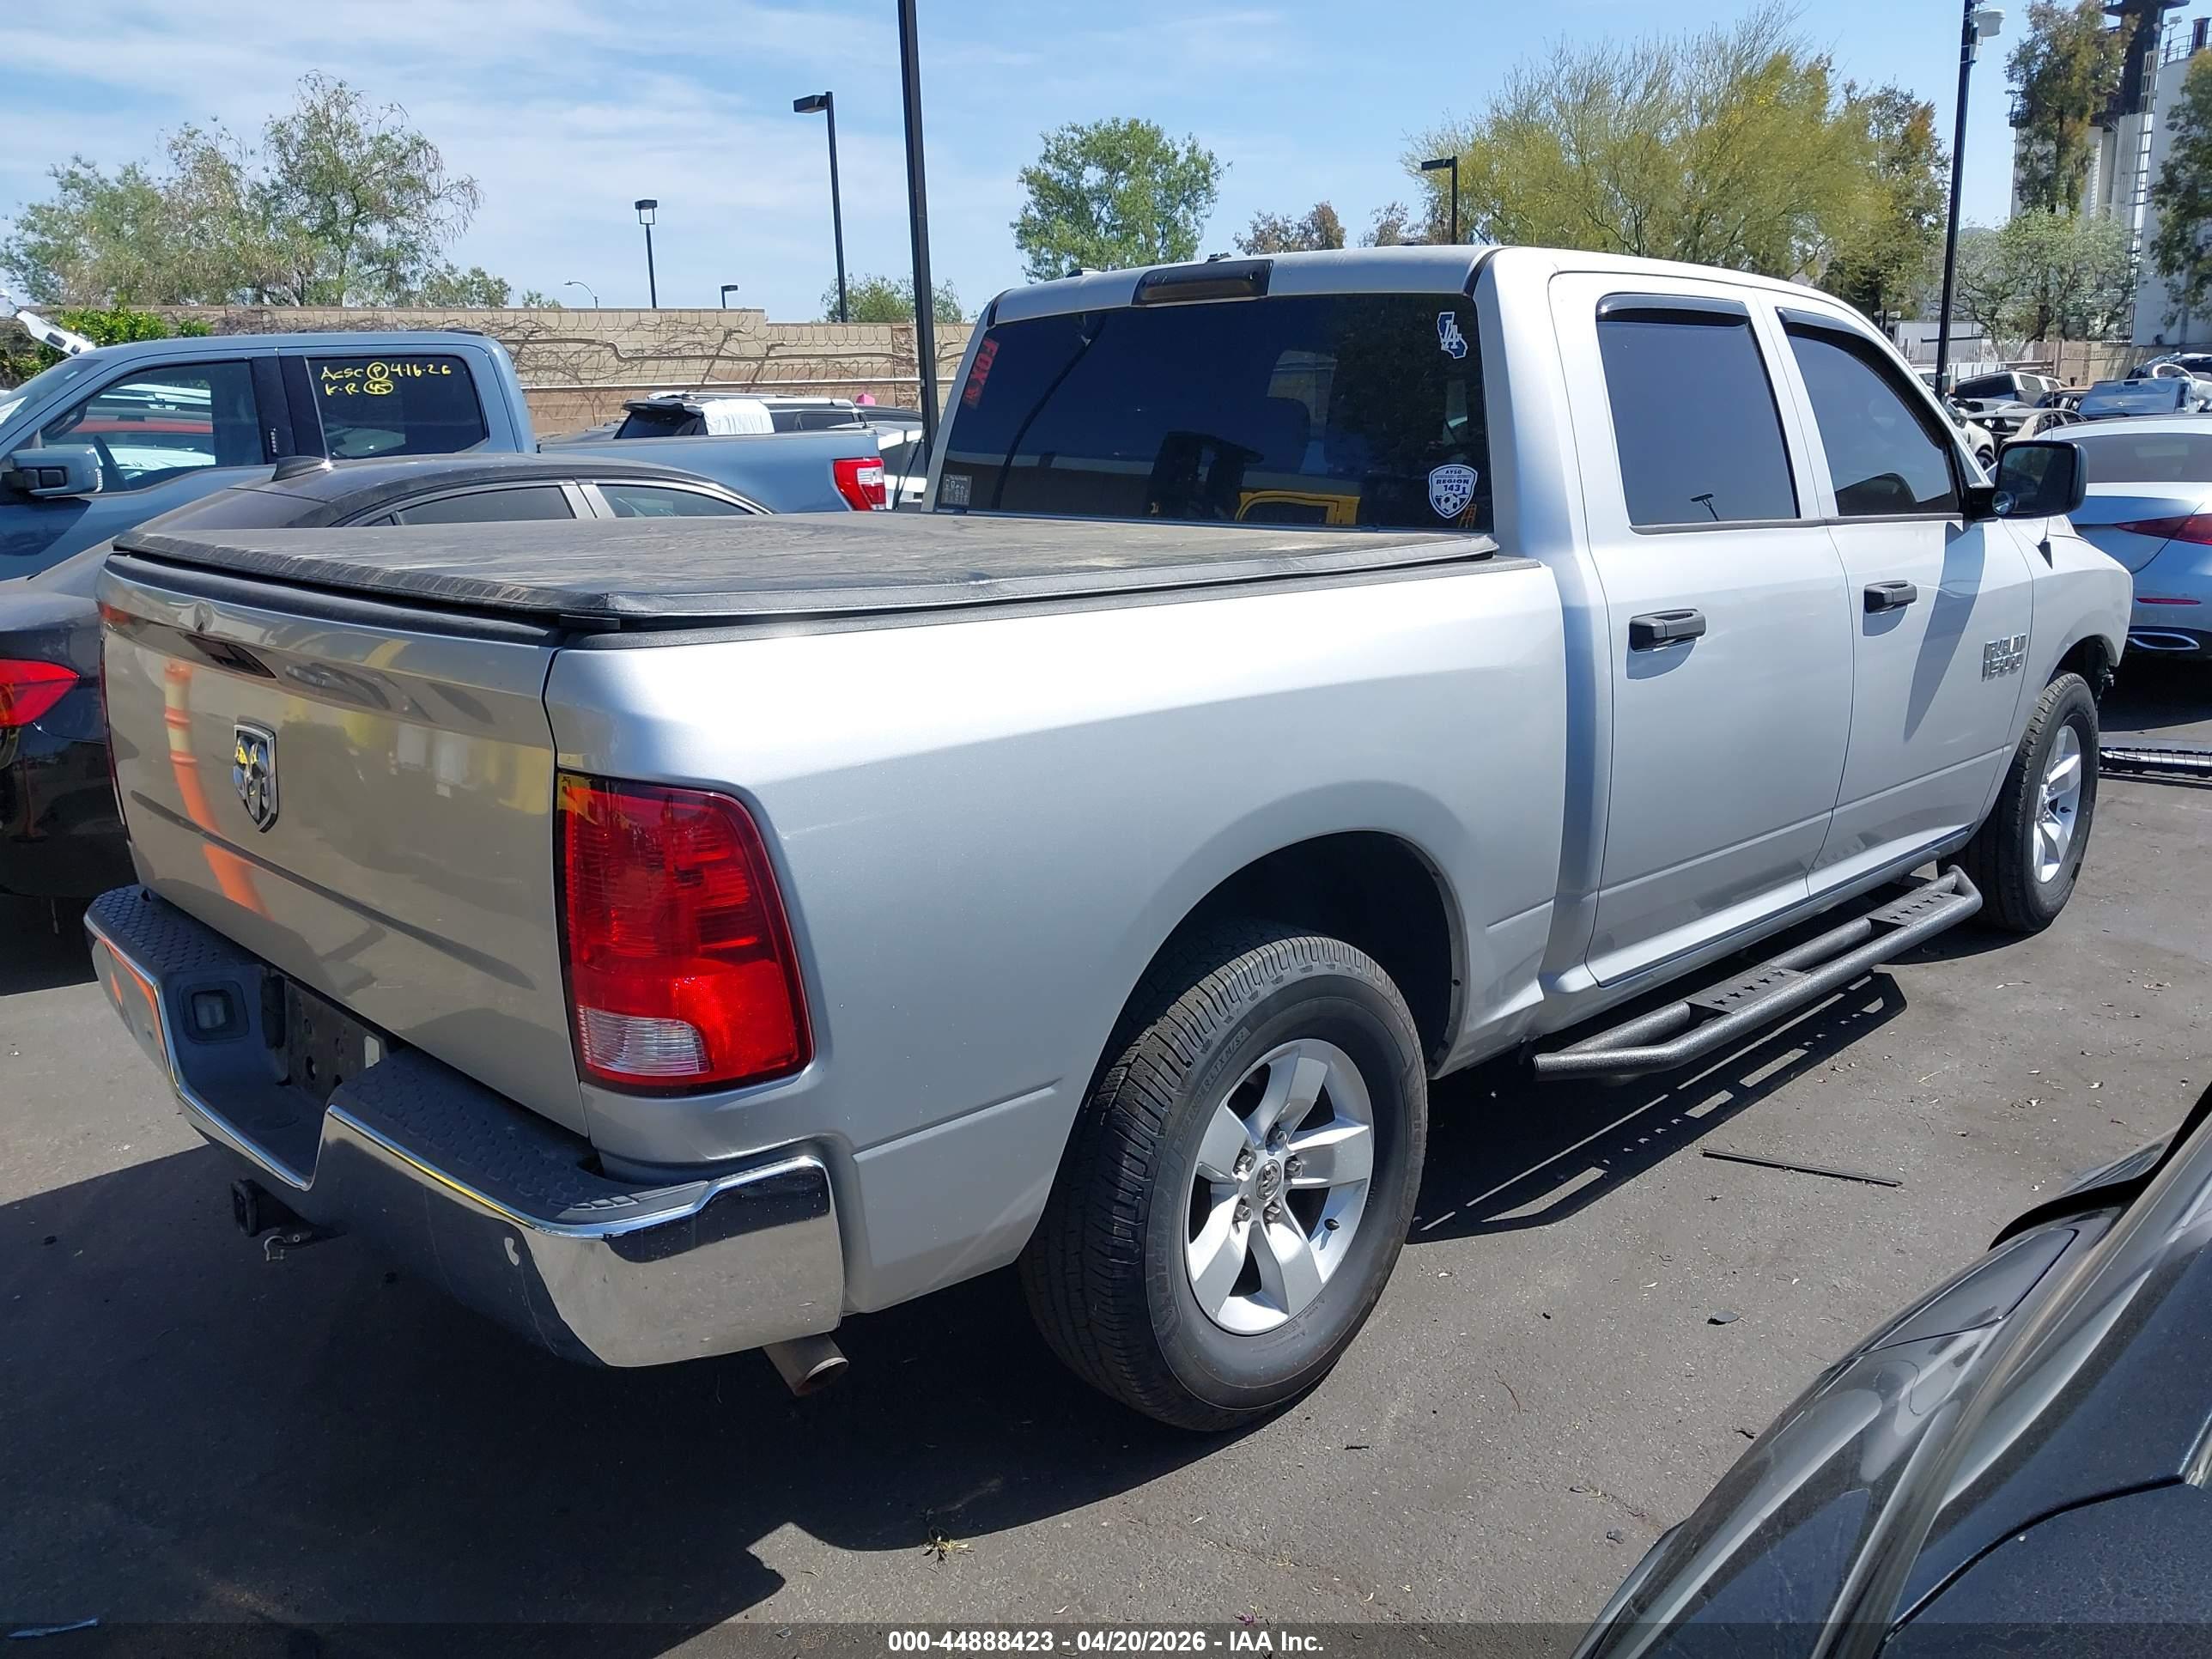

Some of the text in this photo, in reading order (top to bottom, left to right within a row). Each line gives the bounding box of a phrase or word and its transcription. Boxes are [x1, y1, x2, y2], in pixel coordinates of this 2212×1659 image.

[969, 337, 999, 386] FOX
[1984, 633, 2027, 661] RAM
[1981, 653, 2024, 682] 1500
